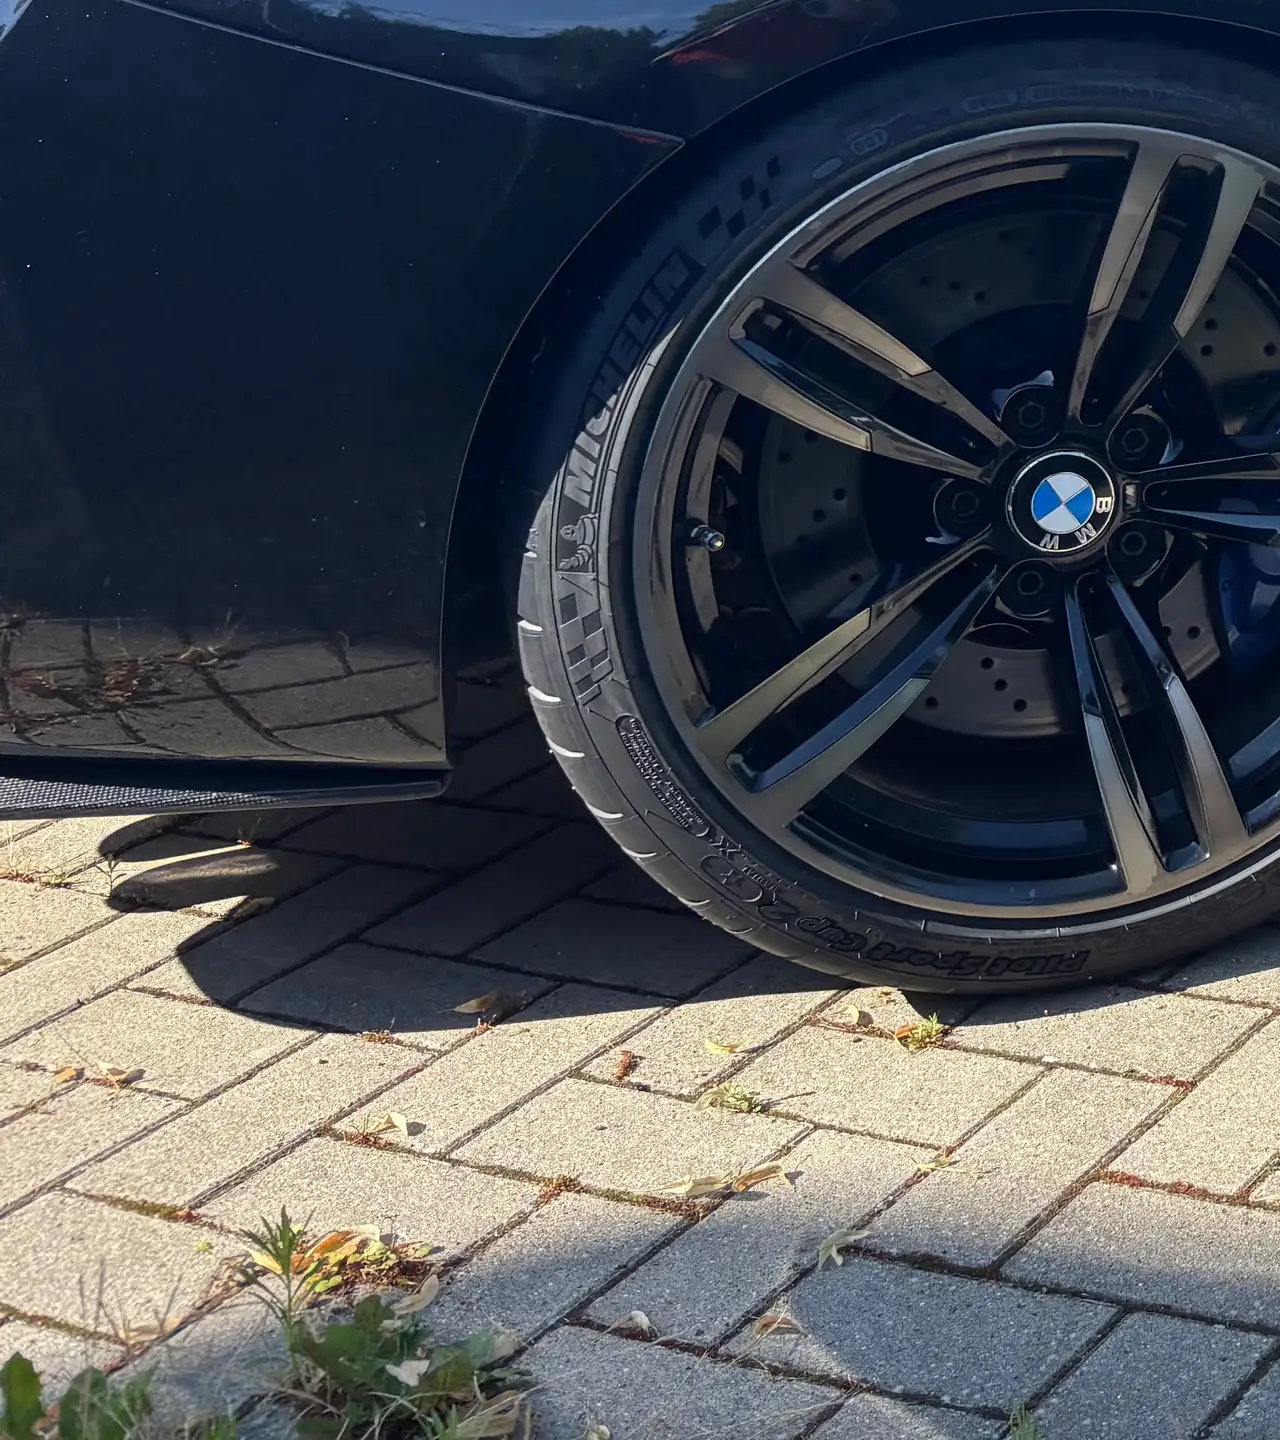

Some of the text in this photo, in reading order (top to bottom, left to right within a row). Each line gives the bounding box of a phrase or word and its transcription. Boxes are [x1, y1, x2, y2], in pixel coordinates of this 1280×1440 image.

[563, 249, 690, 508] MICHELIN
[1039, 496, 1112, 550] BMW
[757, 900, 1091, 978] Pilot Sport Cup 2
